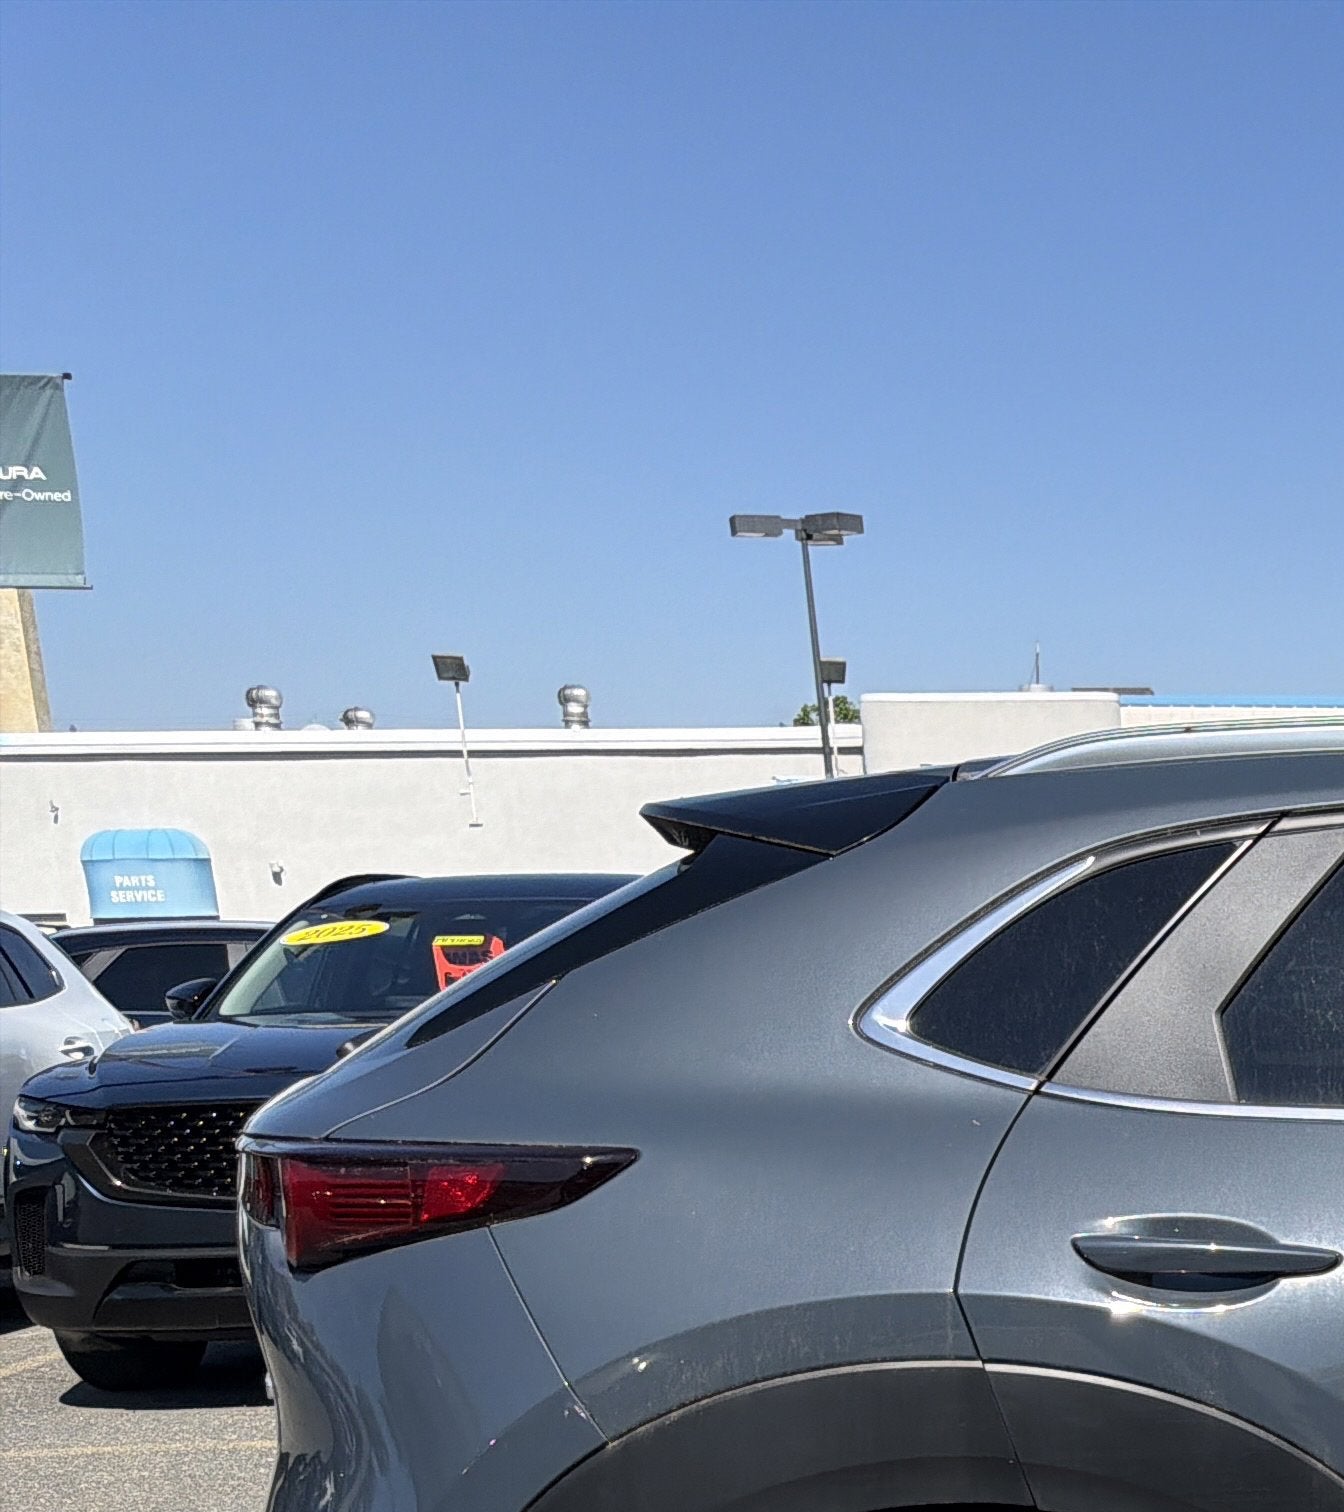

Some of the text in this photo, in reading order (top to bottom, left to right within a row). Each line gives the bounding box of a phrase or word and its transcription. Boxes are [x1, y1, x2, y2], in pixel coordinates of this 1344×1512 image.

[114, 874, 156, 888] PARTS
[110, 889, 166, 903] SERVICE
[297, 924, 374, 942] 2025
